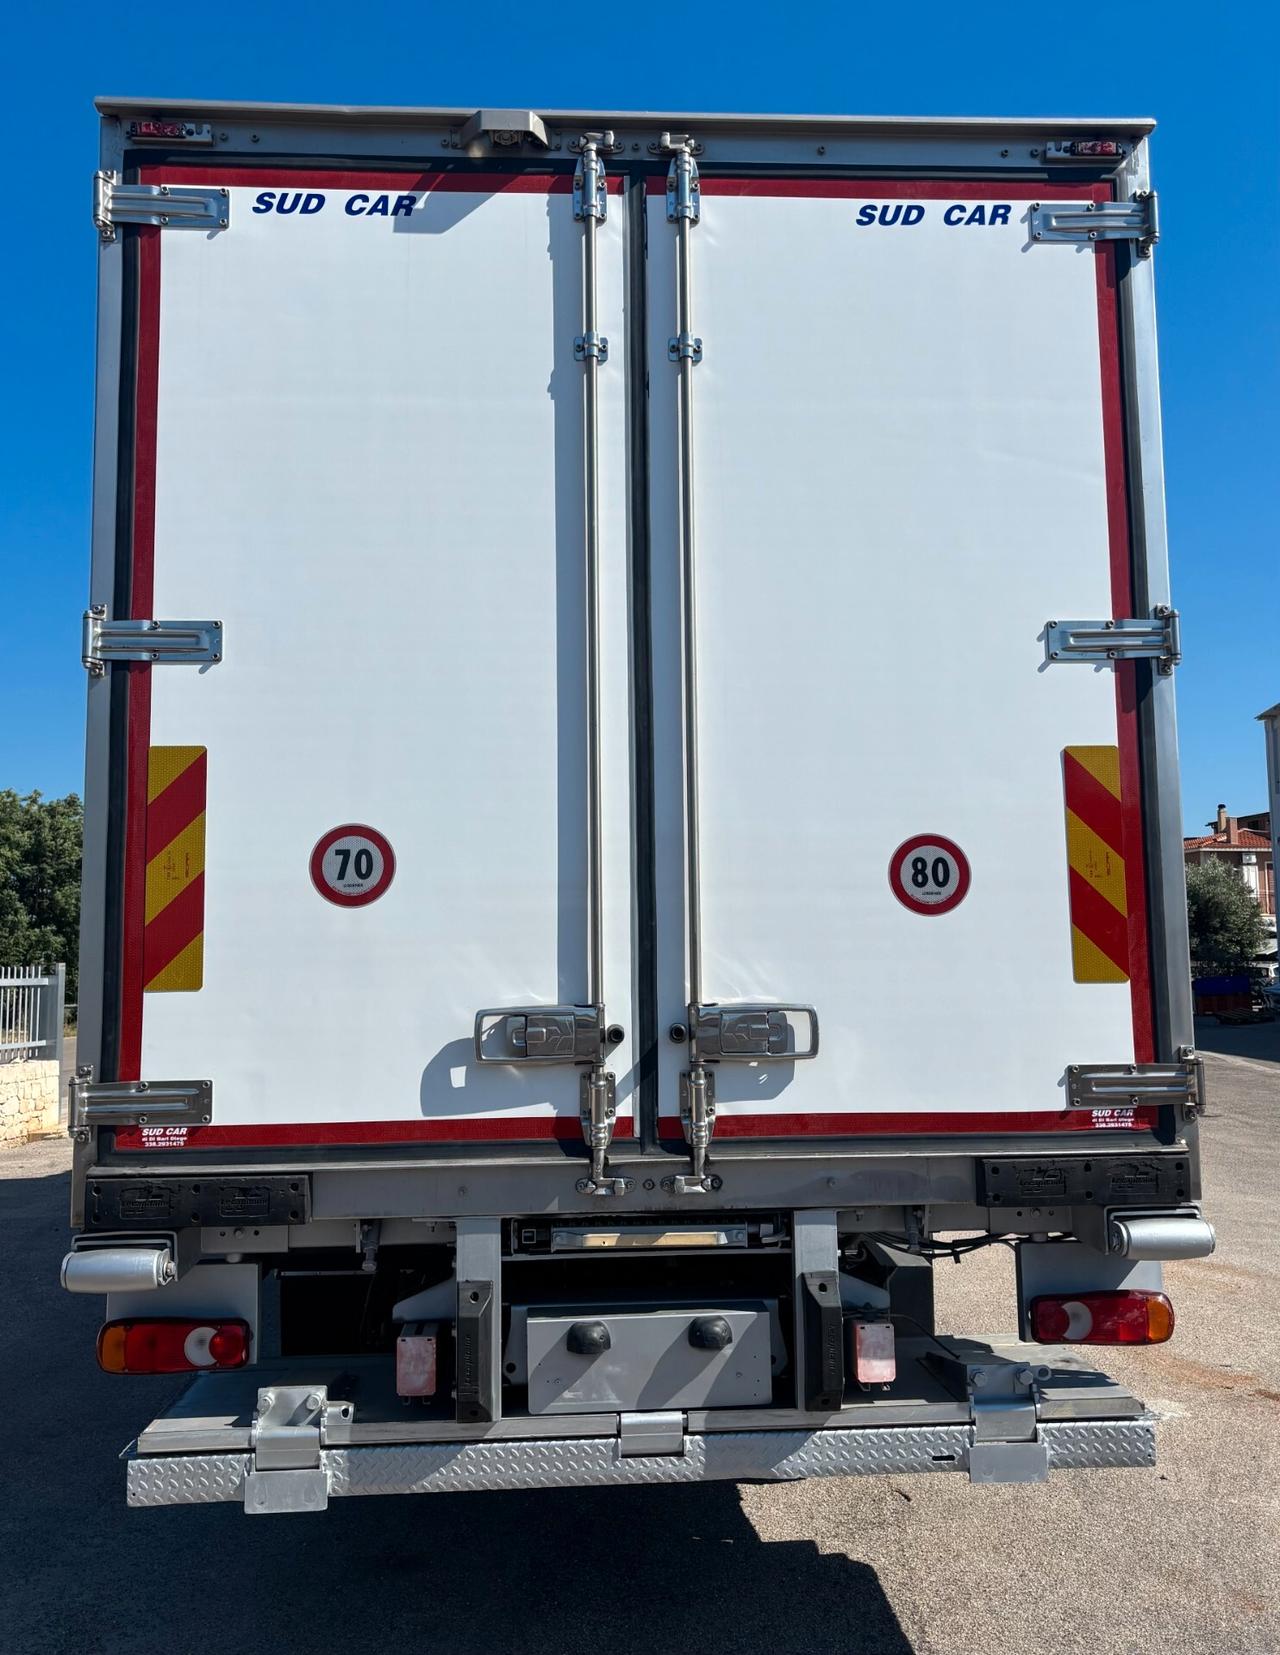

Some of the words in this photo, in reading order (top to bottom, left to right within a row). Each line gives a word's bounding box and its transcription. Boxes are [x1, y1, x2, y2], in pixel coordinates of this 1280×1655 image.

[252, 192, 326, 215] SUD
[345, 194, 417, 217] CAR
[855, 204, 926, 226] SUD
[943, 204, 1012, 226] CAR
[334, 848, 373, 881] 70
[911, 856, 950, 888] 80
[1091, 1109, 1112, 1117] SUD
[1113, 1109, 1134, 1117] CAR
[141, 1127, 164, 1136] SUD
[165, 1127, 188, 1136] CAR
